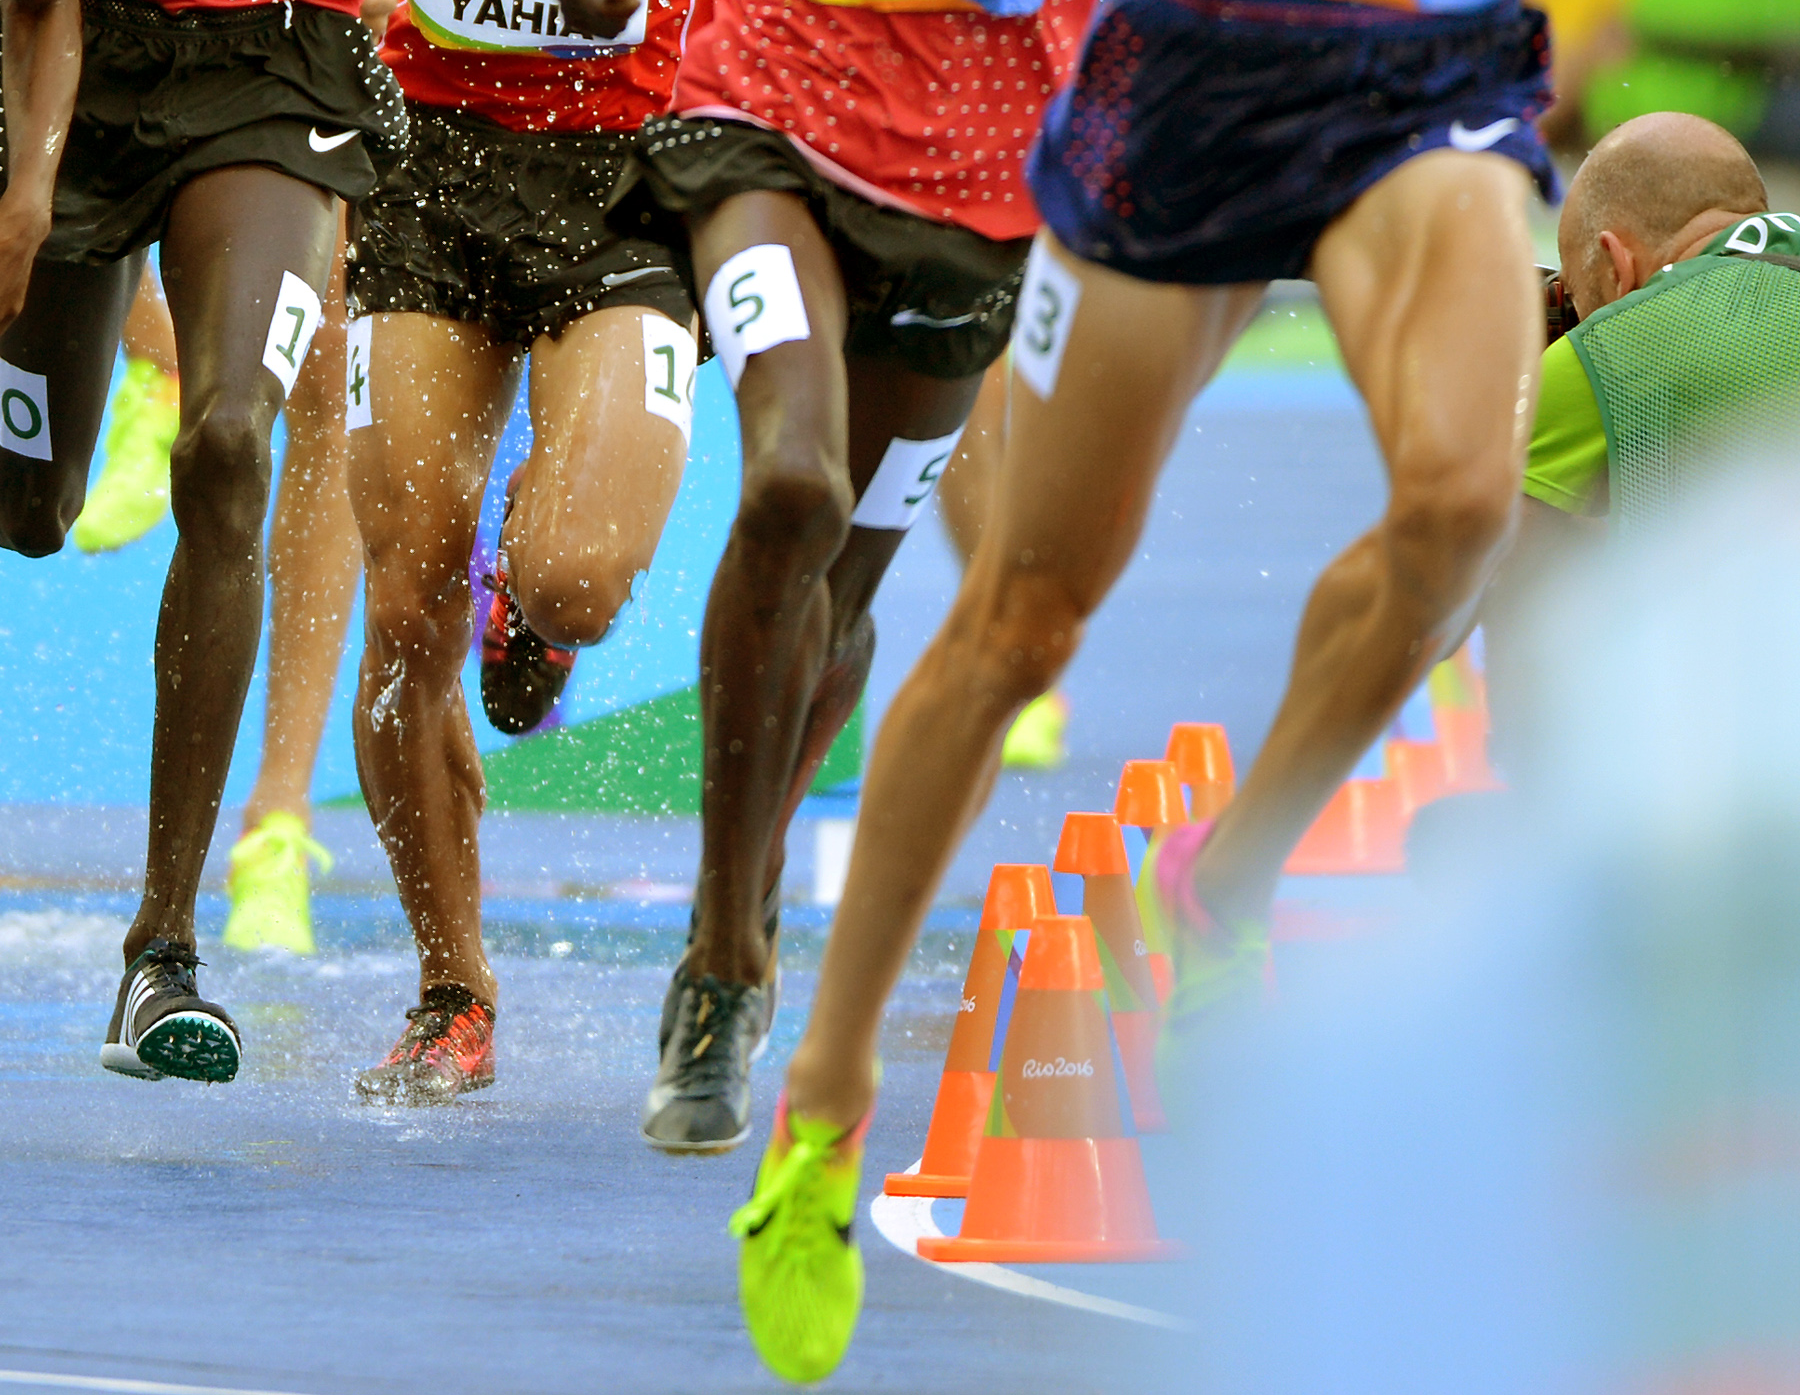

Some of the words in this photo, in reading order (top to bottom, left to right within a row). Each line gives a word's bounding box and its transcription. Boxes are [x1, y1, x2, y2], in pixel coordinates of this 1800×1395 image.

[729, 271, 765, 334] 5
[1026, 282, 1062, 354] 3
[653, 345, 696, 413] 1
[904, 453, 951, 505] 5
[1023, 1056, 1094, 1079] Rio2016
